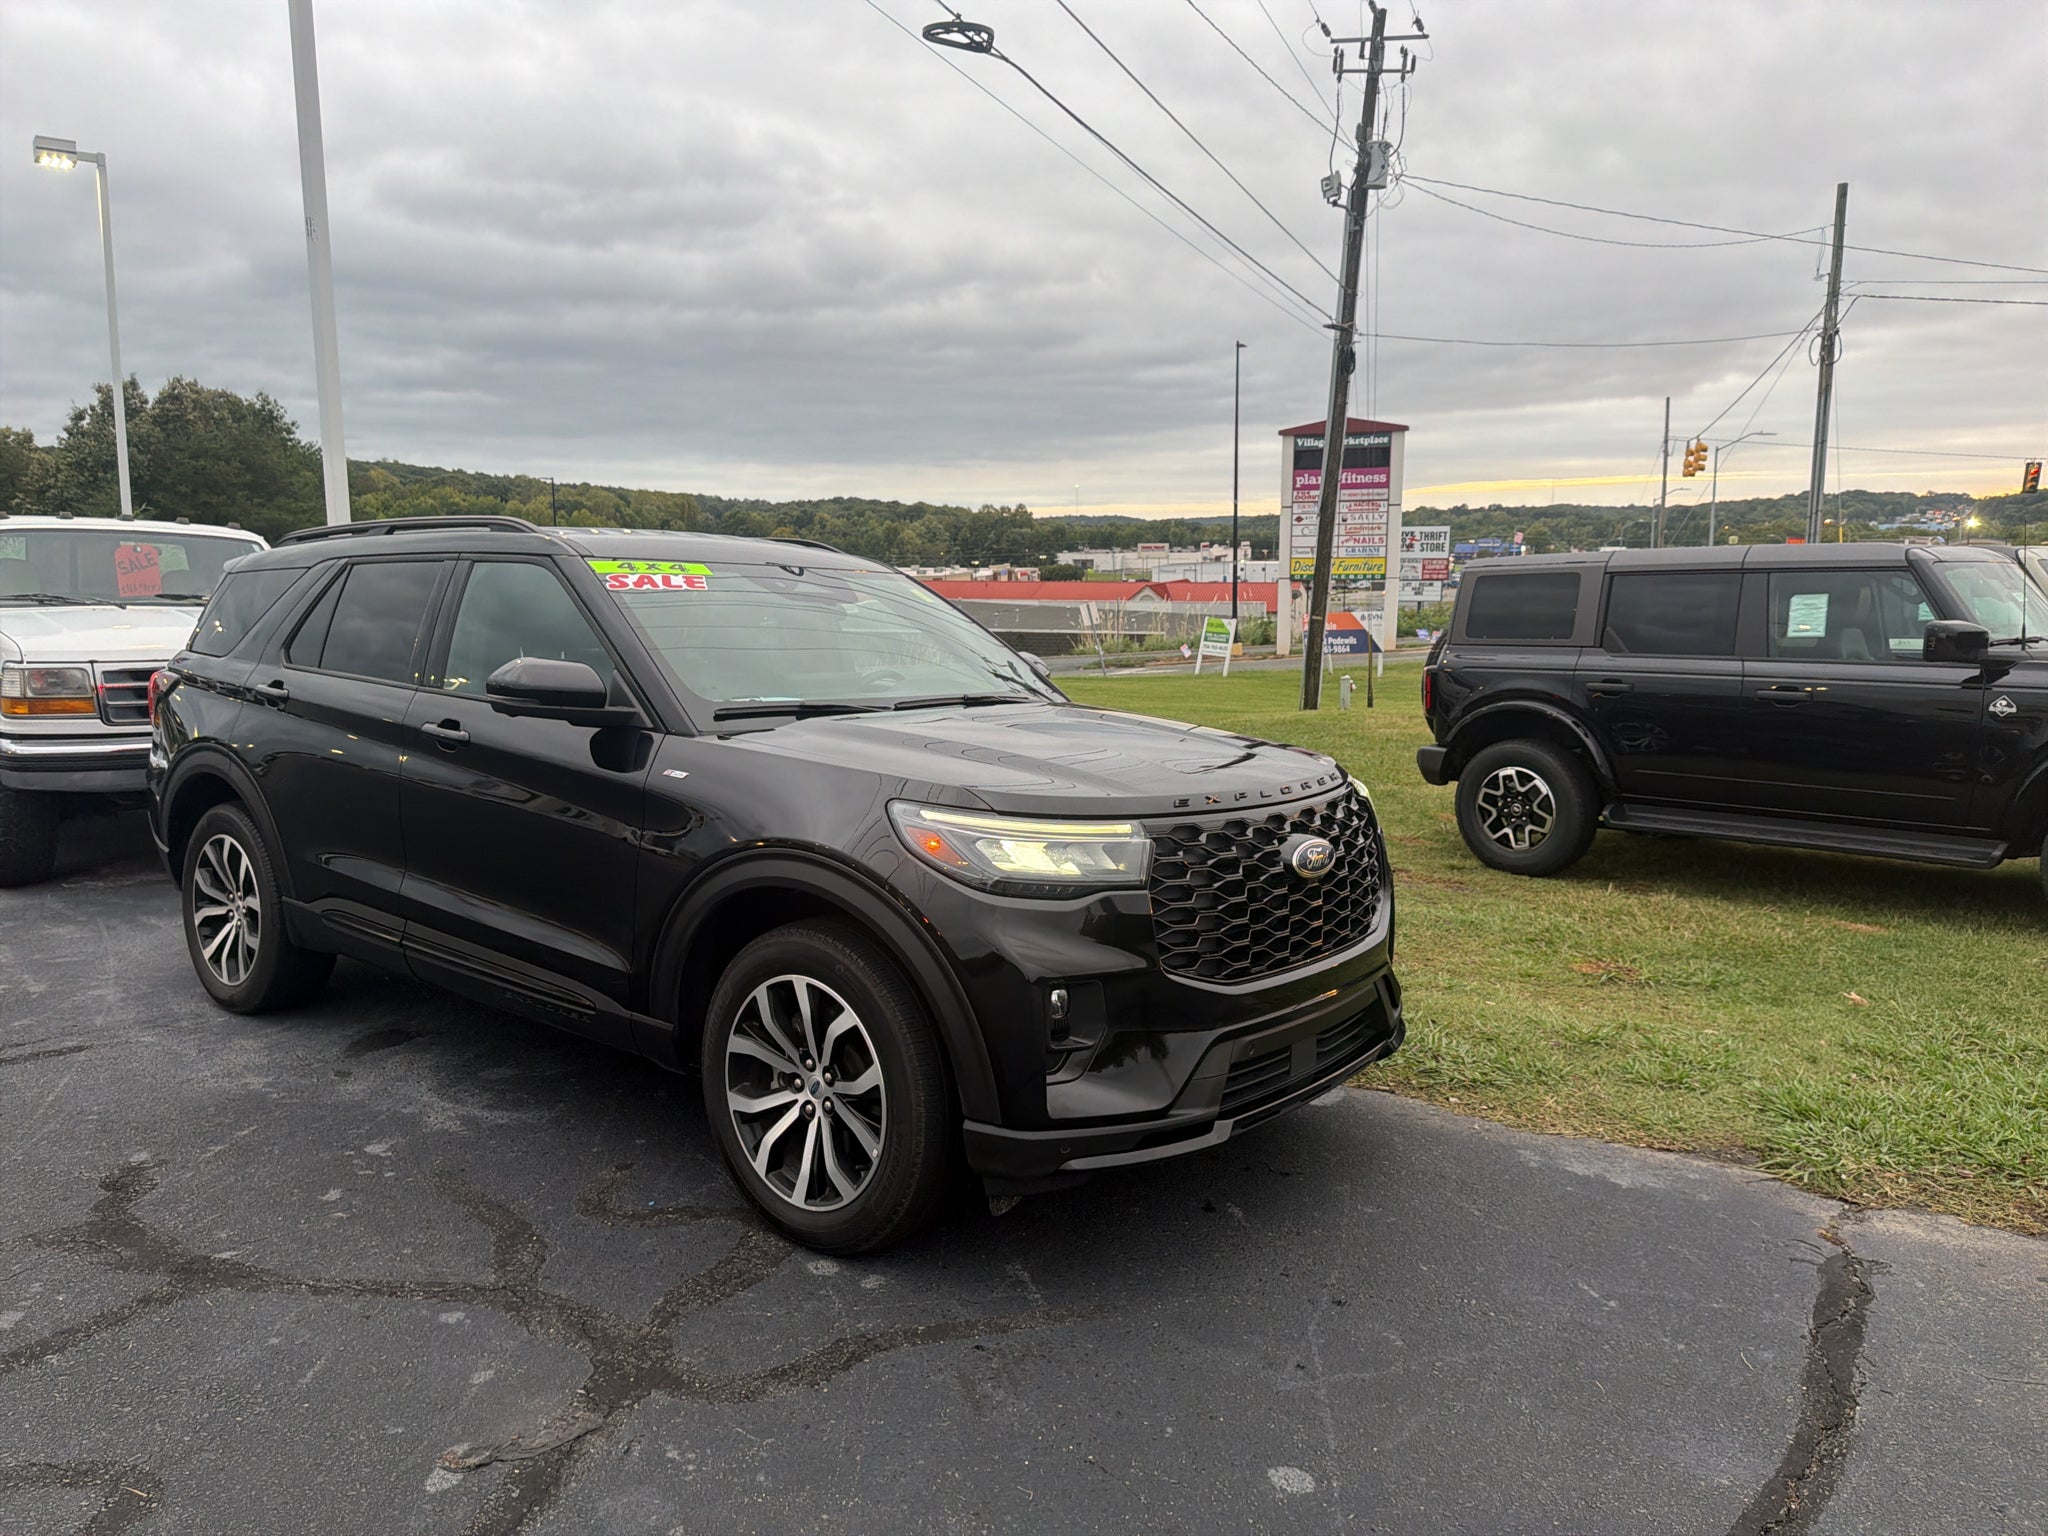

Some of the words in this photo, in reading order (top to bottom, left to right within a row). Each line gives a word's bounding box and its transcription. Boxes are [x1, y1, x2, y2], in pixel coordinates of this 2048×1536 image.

[1296, 438, 1325, 448] Villag
[1343, 436, 1388, 446] rketplace
[1341, 472, 1387, 484] fitness
[1353, 536, 1384, 544] NAILS
[1419, 531, 1448, 541] THRIFT
[1420, 543, 1446, 552] STORE
[118, 551, 159, 575] SALE
[1337, 560, 1384, 572] Furniture
[607, 574, 707, 590] SALE
[1367, 613, 1382, 621] SVN
[1173, 772, 1342, 809] EXPLORER
[1307, 846, 1331, 869] Ford
